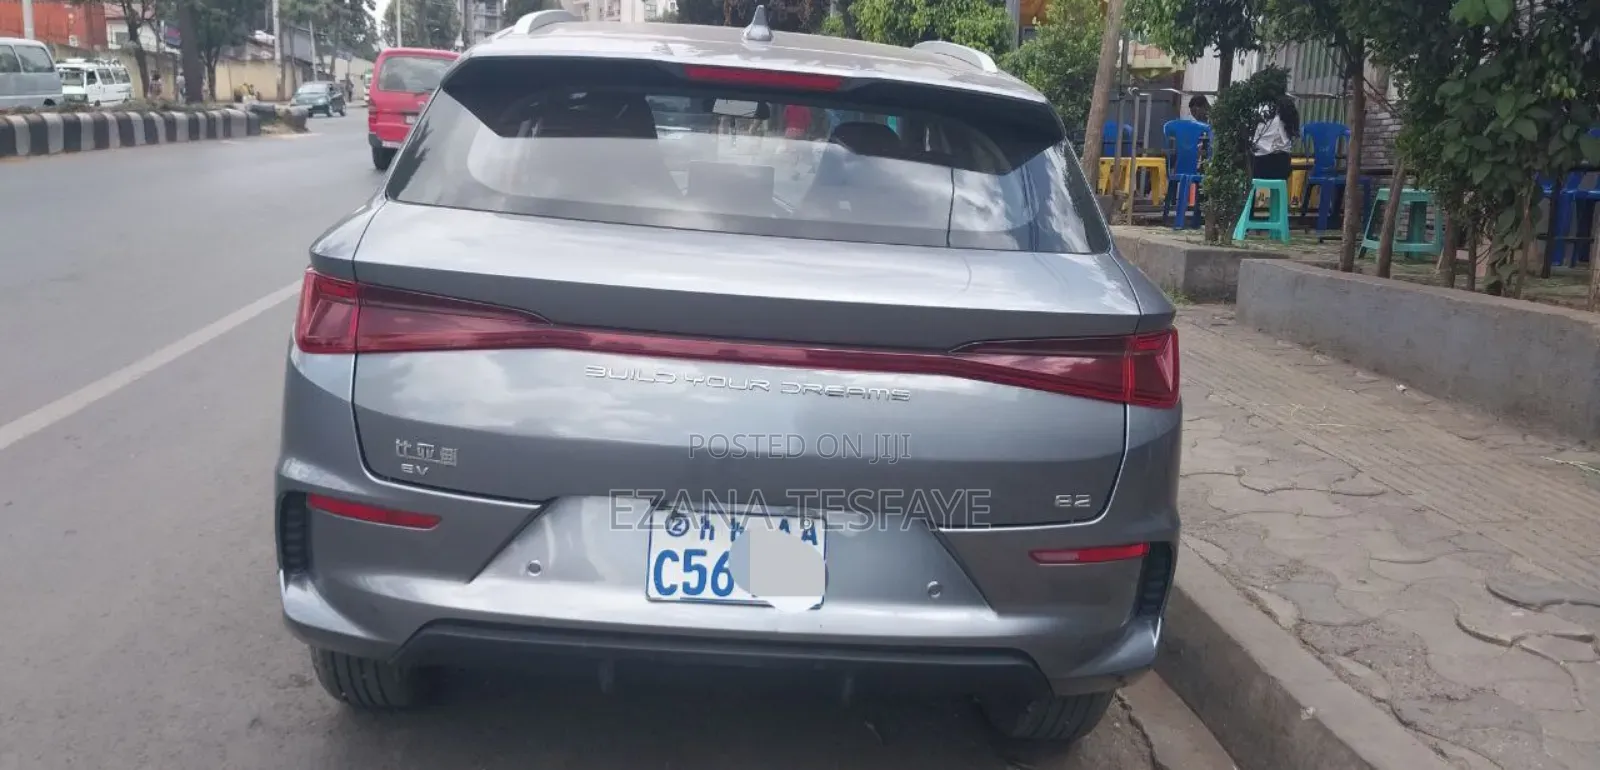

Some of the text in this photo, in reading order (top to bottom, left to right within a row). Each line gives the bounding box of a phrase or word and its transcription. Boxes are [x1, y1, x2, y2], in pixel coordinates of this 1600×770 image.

[585, 365, 911, 401] BUILD YOUR DREAMS
[401, 463, 429, 476] EV
[653, 549, 735, 597] C56
